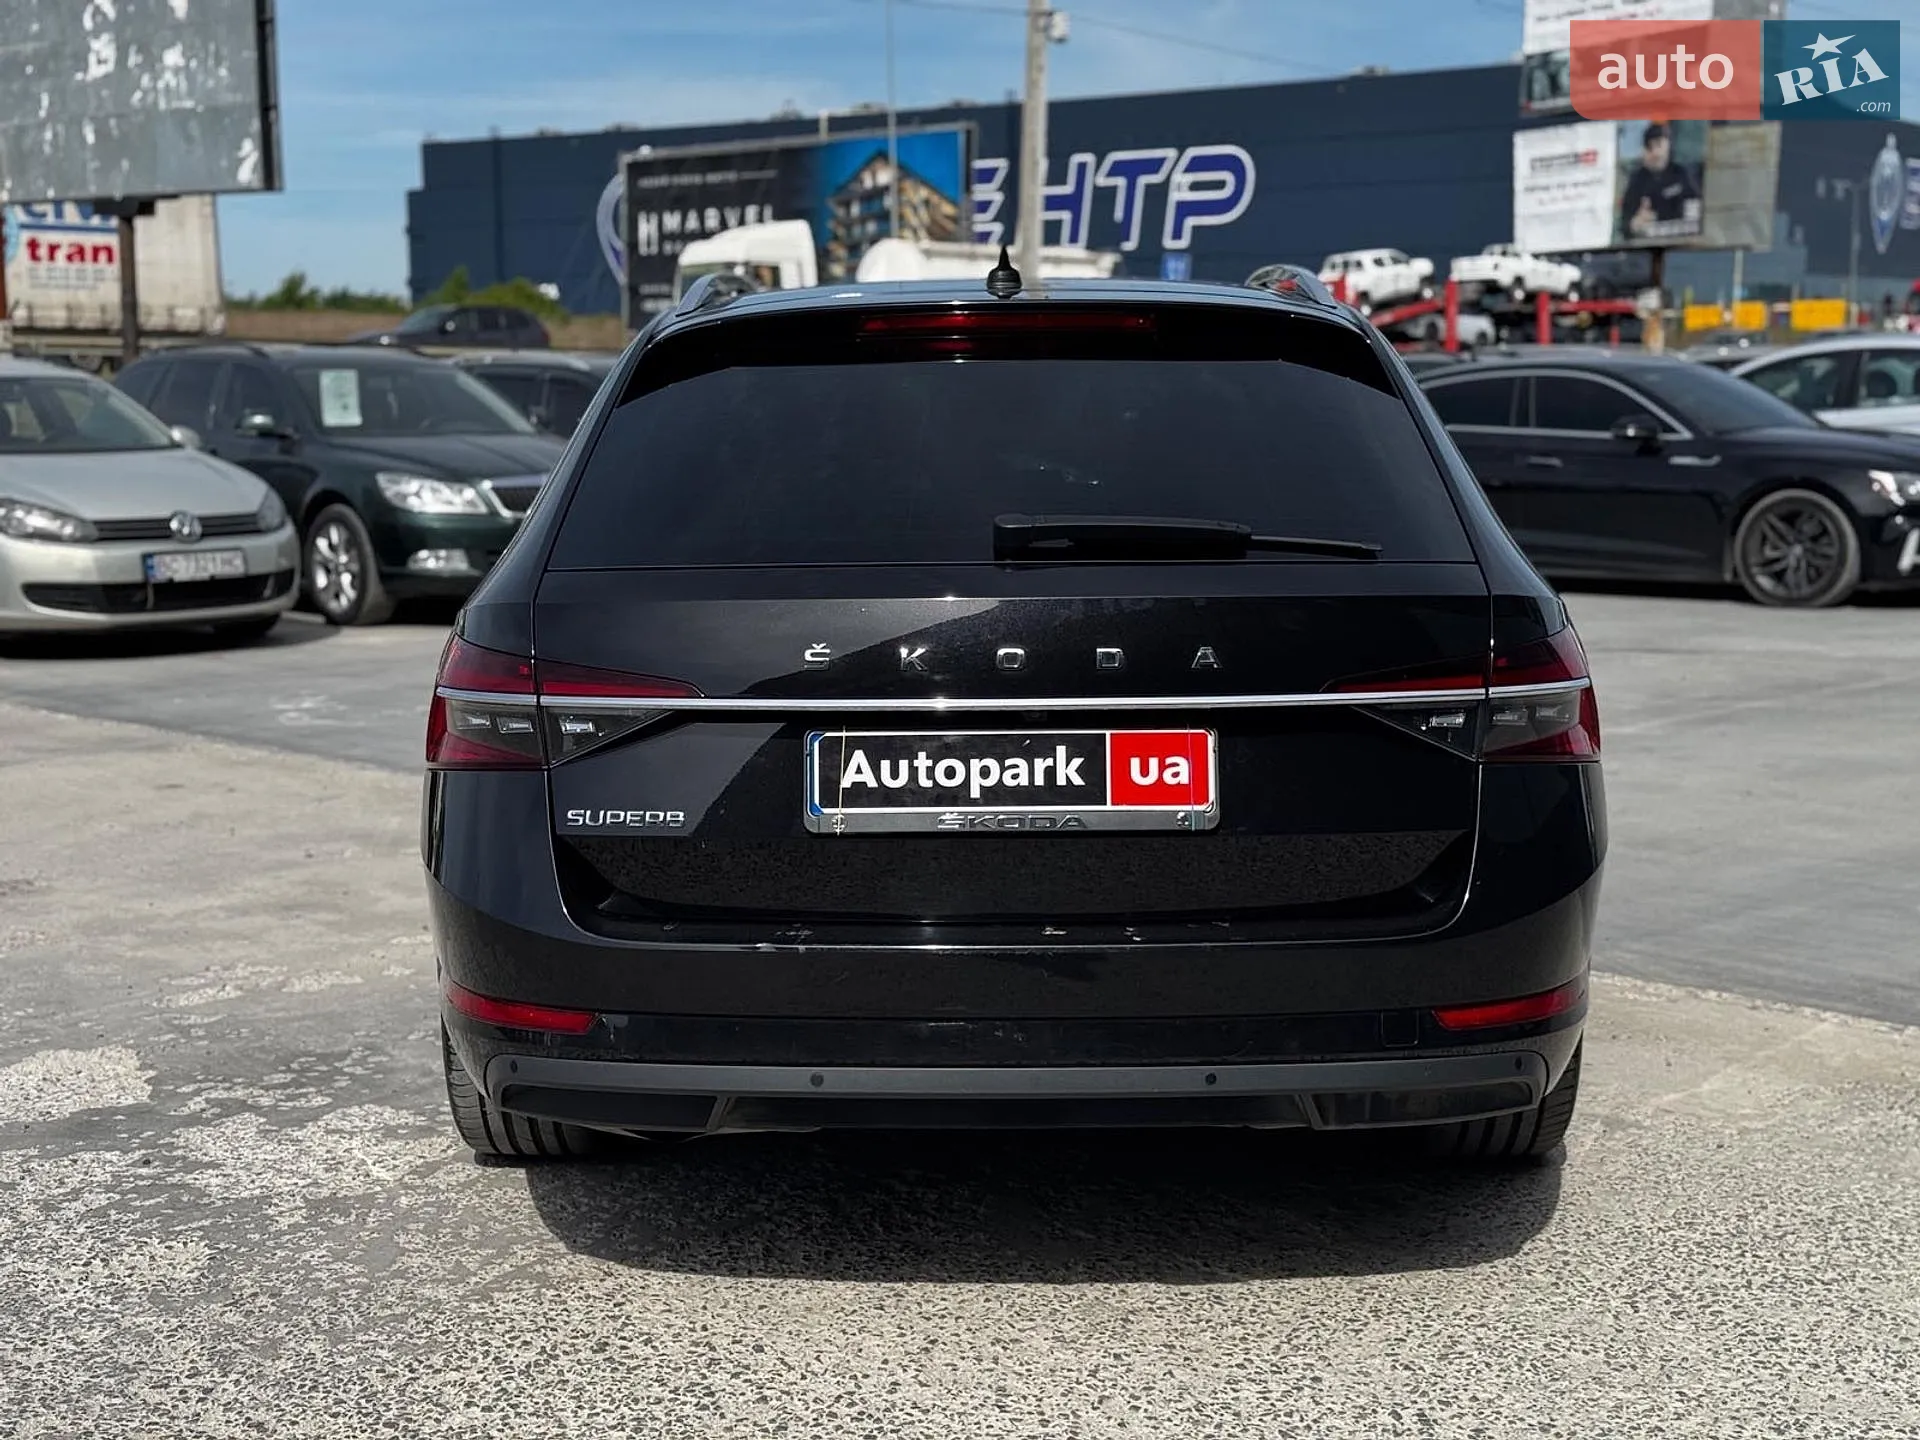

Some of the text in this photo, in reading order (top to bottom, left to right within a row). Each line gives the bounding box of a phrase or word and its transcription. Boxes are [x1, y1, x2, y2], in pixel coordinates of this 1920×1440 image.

[803, 643, 1223, 671] ŠKODA
[842, 745, 1190, 799] Autopark ua
[566, 809, 686, 827] SUPERB
[937, 812, 1090, 831] ŠKODA
